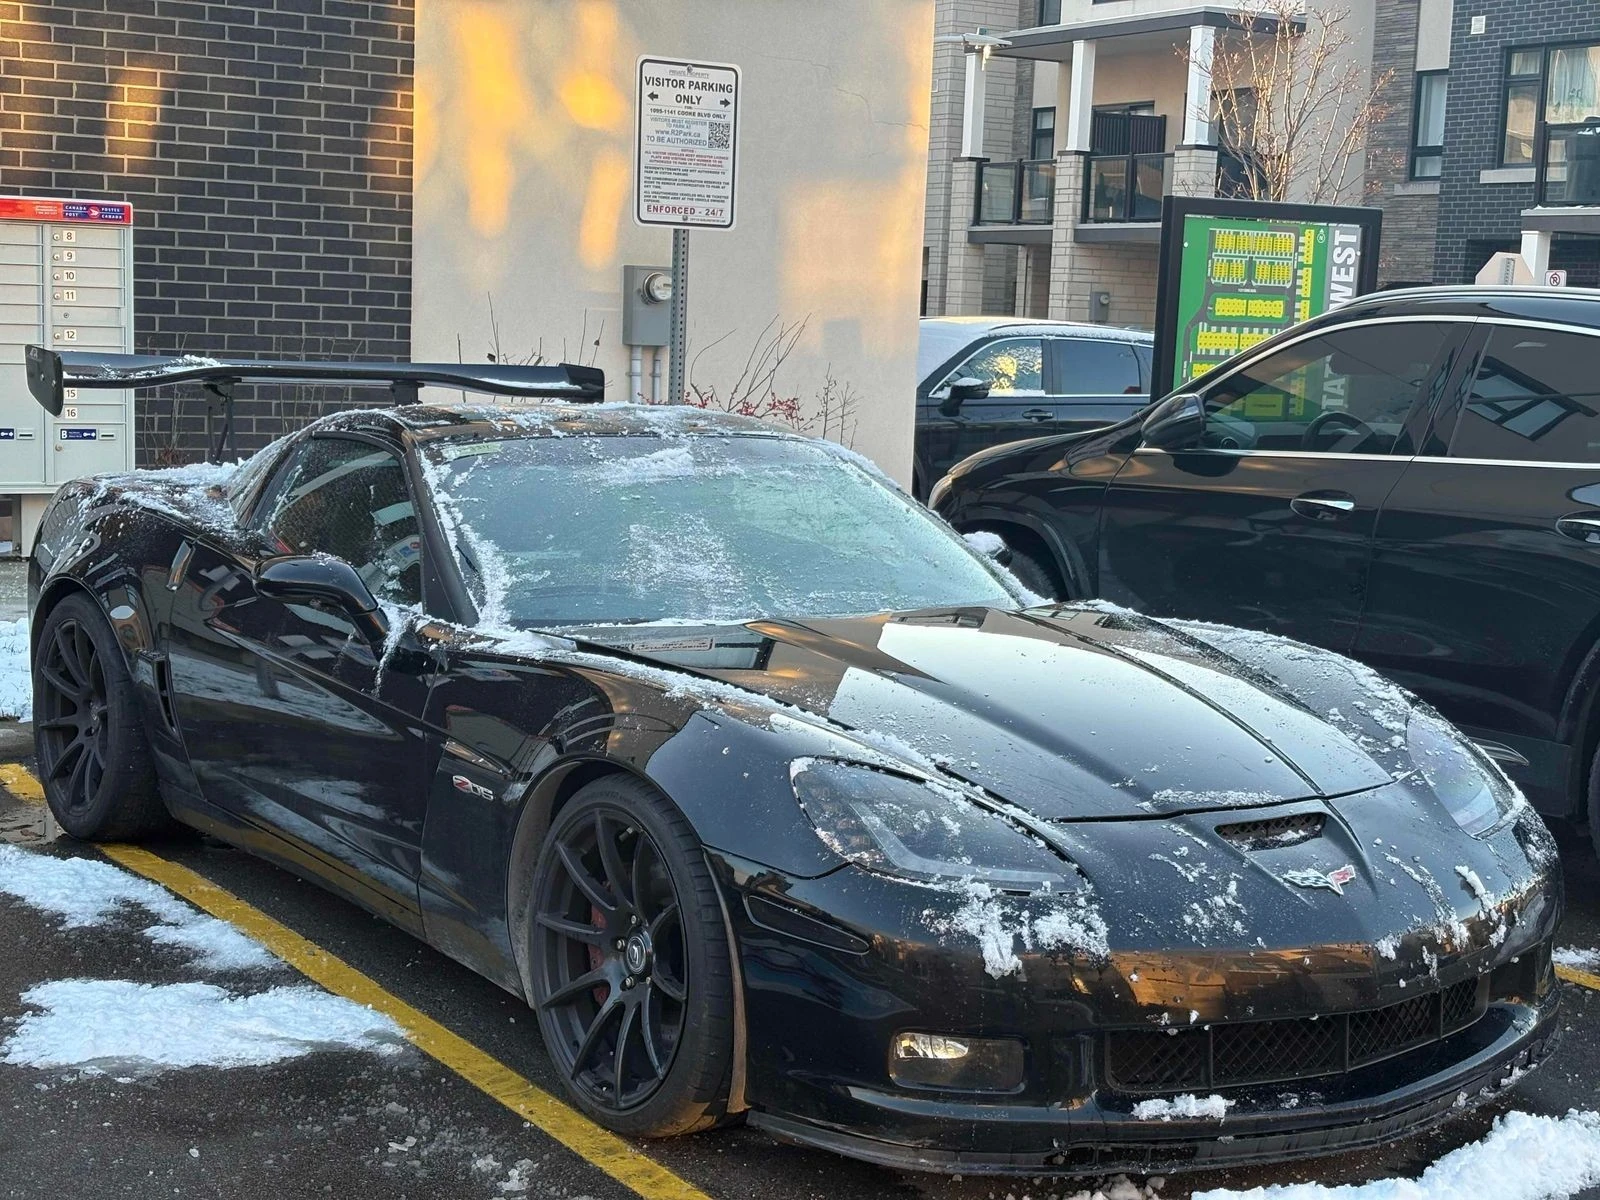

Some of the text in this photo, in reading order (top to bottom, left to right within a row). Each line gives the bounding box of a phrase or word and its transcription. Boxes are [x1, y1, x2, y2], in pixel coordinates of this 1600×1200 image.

[644, 76, 733, 93] VISITOR PARKING
[675, 94, 702, 105] ONLY
[655, 129, 700, 138] www.R2Park.ca
[666, 137, 707, 146] AUTHORIZED
[647, 205, 695, 215] ENFORCED
[66, 232, 72, 240] 8
[67, 252, 72, 260] 9
[66, 409, 76, 417] 16
